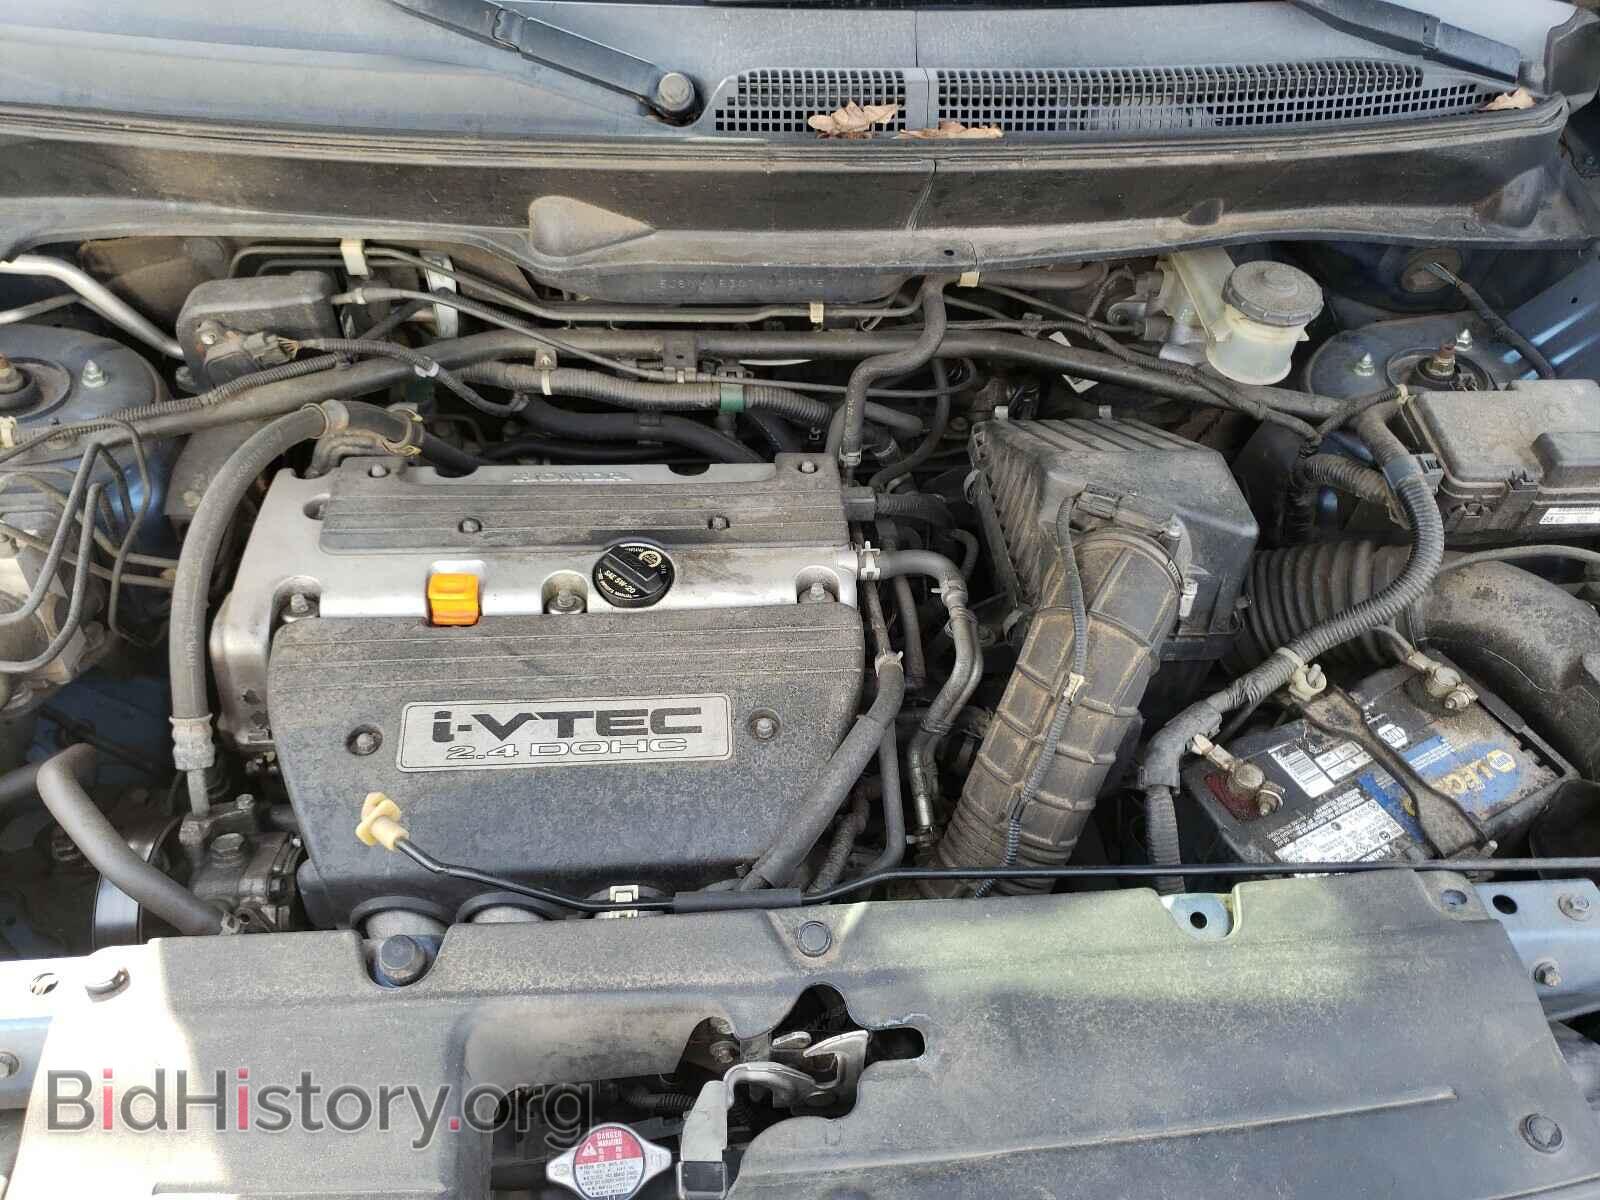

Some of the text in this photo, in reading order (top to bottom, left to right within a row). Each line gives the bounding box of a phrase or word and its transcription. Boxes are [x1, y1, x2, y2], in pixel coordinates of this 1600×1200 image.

[604, 570, 617, 581] SAE
[614, 578, 636, 594] 5W-20
[432, 707, 702, 743] i-VTEC
[446, 738, 688, 760] 2.4 DOHC
